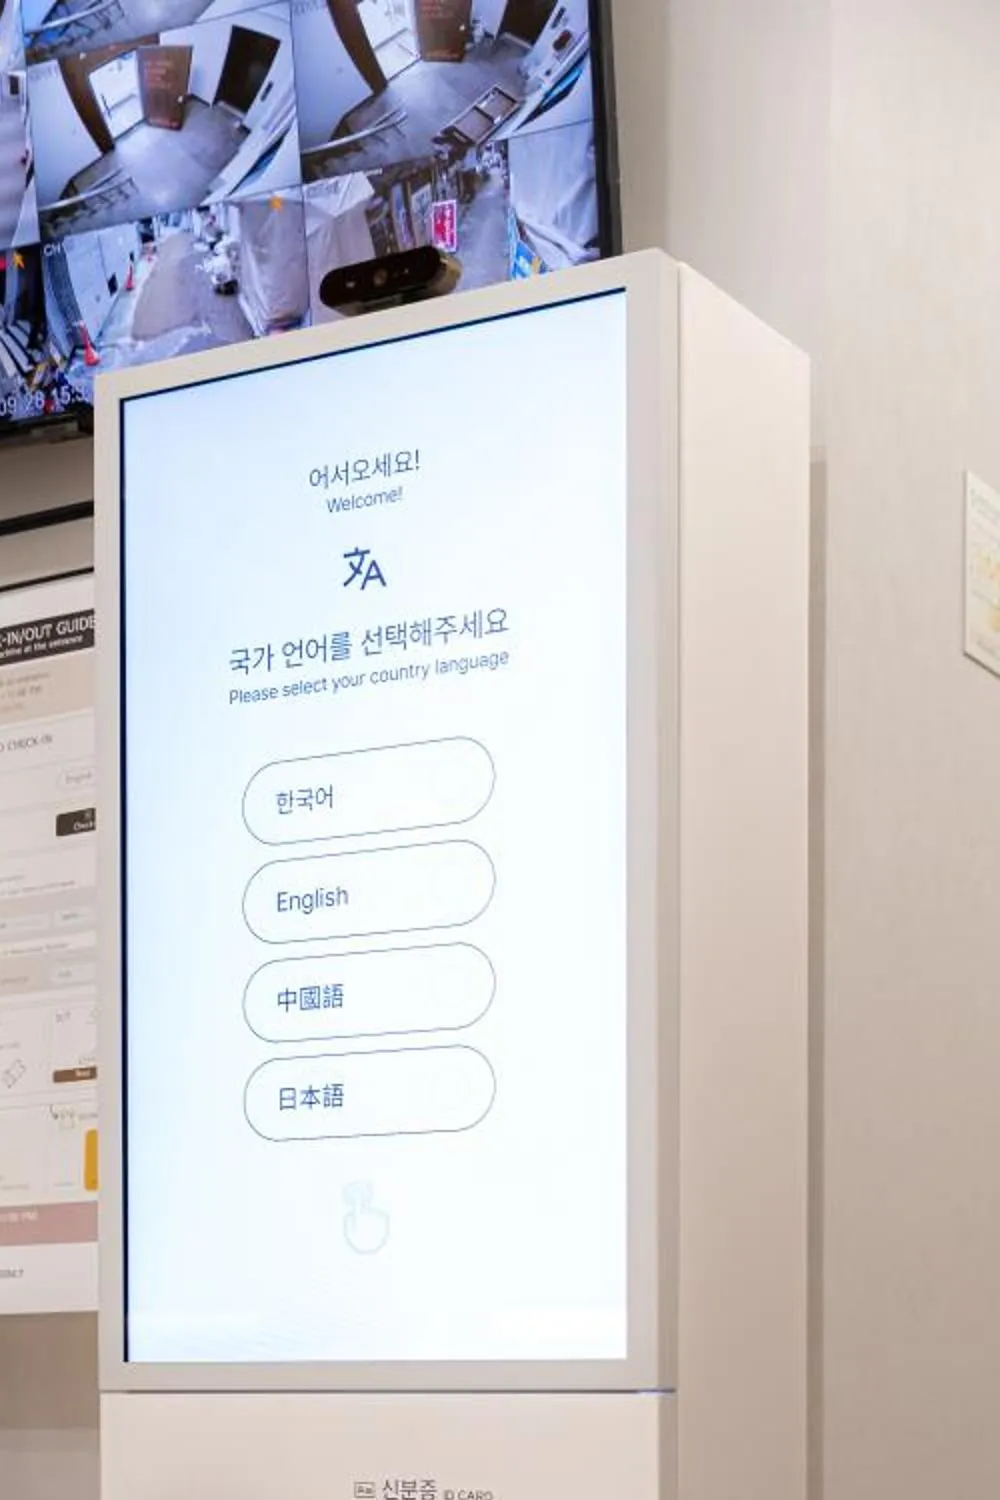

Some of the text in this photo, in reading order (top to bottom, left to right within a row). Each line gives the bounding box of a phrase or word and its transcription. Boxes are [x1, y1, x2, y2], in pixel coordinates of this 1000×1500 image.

[309, 449, 420, 489] 어서오세요!
[327, 486, 403, 513] Welcome!
[229, 607, 509, 675] 국가 언어를 선택해주세요
[229, 651, 510, 705] Please select your country language
[276, 784, 334, 815] 한국어
[277, 887, 349, 915] English
[277, 983, 344, 1013] 中國語
[279, 1083, 344, 1112] 日本語
